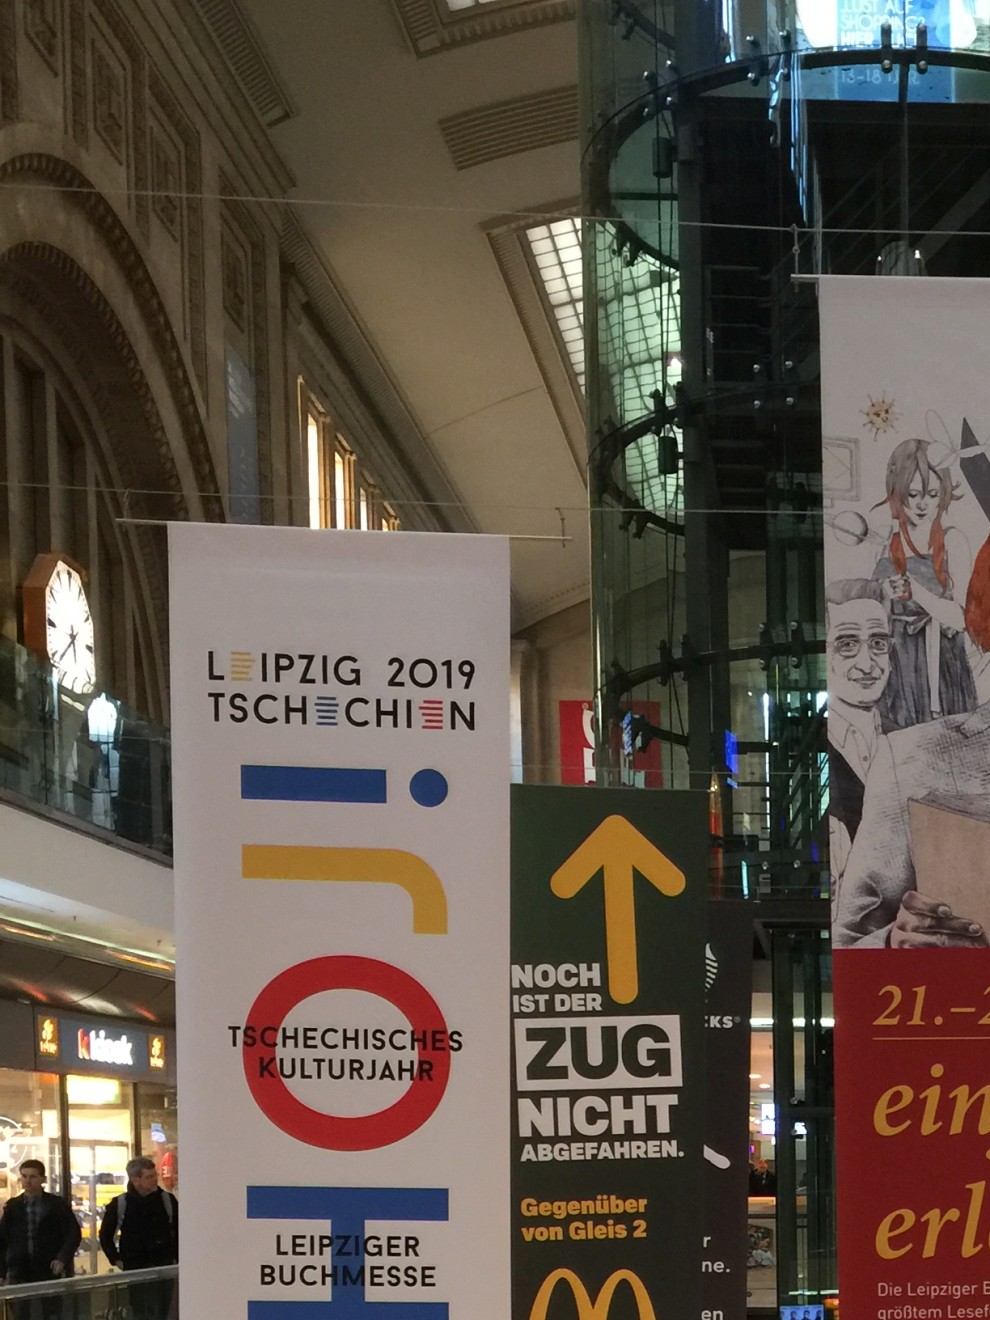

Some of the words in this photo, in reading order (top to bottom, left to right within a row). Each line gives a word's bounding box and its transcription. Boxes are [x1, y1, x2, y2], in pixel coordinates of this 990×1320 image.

[207, 650, 362, 687] LEIPZIG
[387, 657, 476, 690] 2019
[207, 692, 476, 731] TSCHECHIEN
[511, 962, 602, 989] NOCH
[512, 994, 550, 1013] IST
[554, 993, 603, 1012] DER
[228, 1025, 464, 1053] TSCHECHISCHES
[525, 1023, 673, 1081] ZUG
[258, 1056, 434, 1082] KULTURJAHR
[517, 1093, 679, 1138] NICHT
[519, 1140, 685, 1163] ABGEFAHREN.
[520, 1194, 648, 1220] Gegenüber
[520, 1225, 564, 1242] von
[568, 1219, 628, 1241] Gleis
[632, 1219, 647, 1239] 2
[274, 1234, 422, 1259] LEIPZIGER
[259, 1264, 438, 1289] BUCHMESSE
[877, 1282, 903, 1297] Die
[907, 1281, 978, 1299] Leipziger
